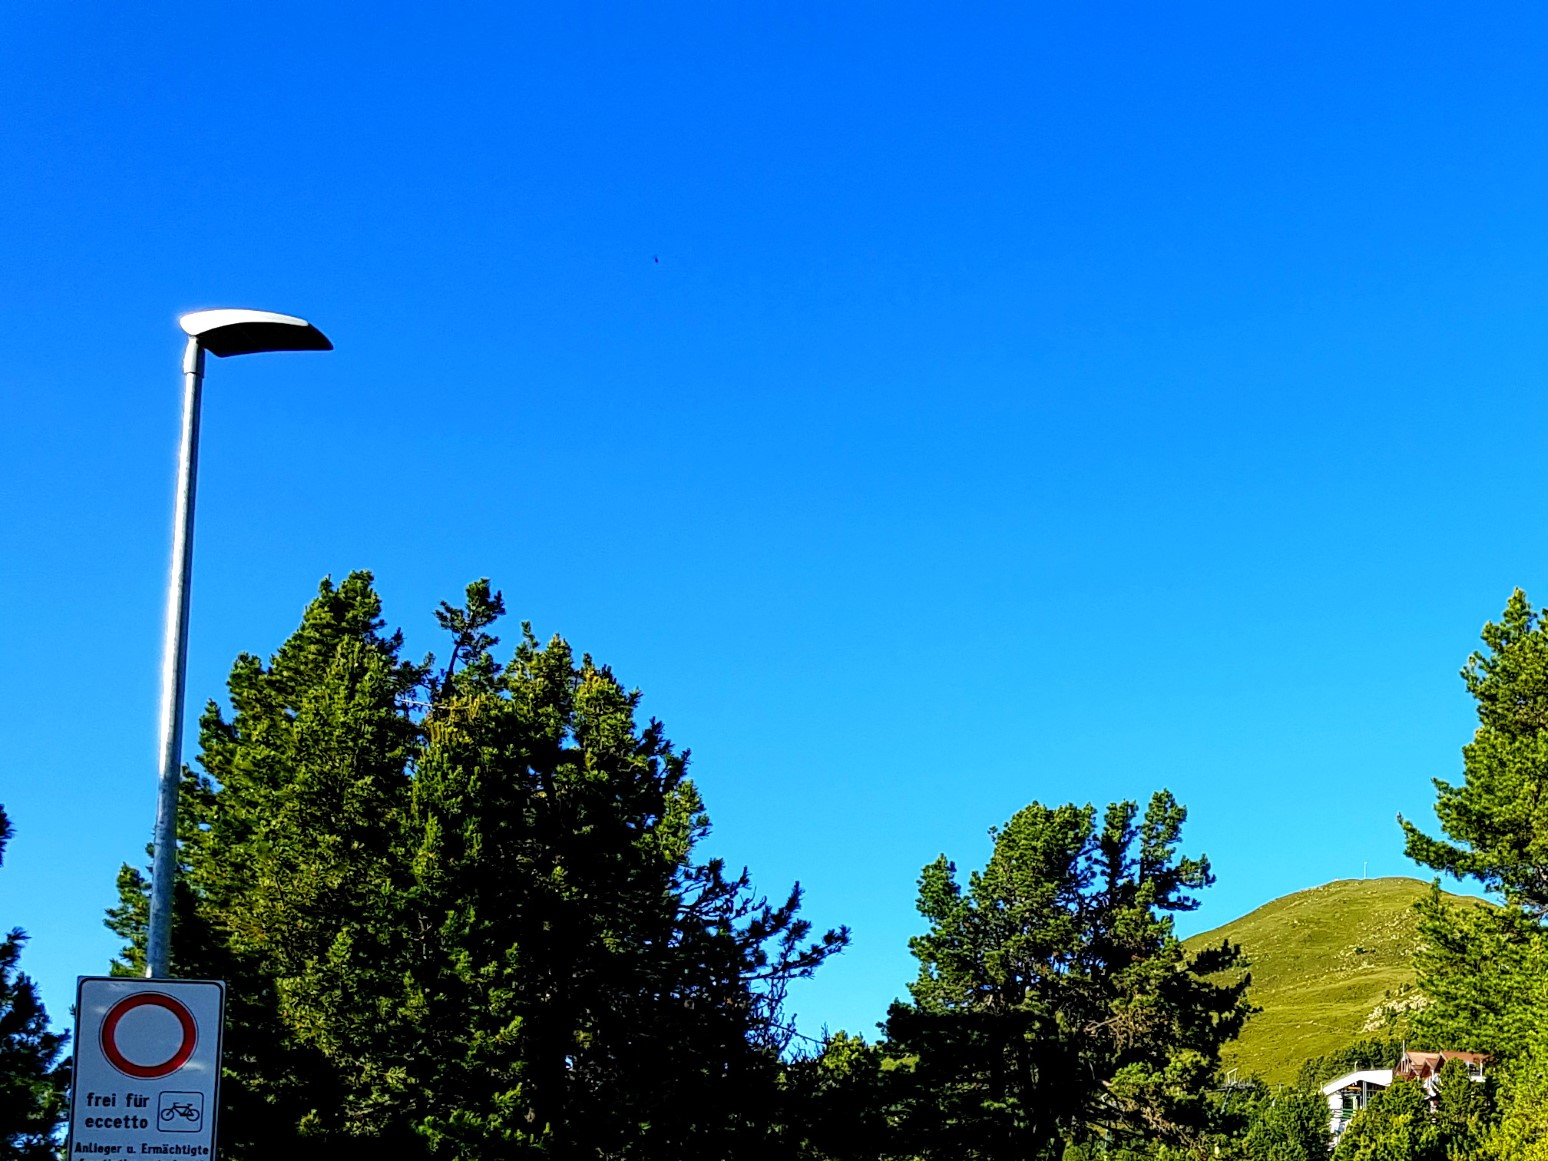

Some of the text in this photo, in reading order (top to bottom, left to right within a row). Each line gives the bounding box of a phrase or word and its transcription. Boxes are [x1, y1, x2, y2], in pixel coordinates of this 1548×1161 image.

[86, 1092, 150, 1108] frei für
[85, 1116, 148, 1129] eccetto
[75, 1142, 209, 1156] Anlieger u. Ermächtigte
